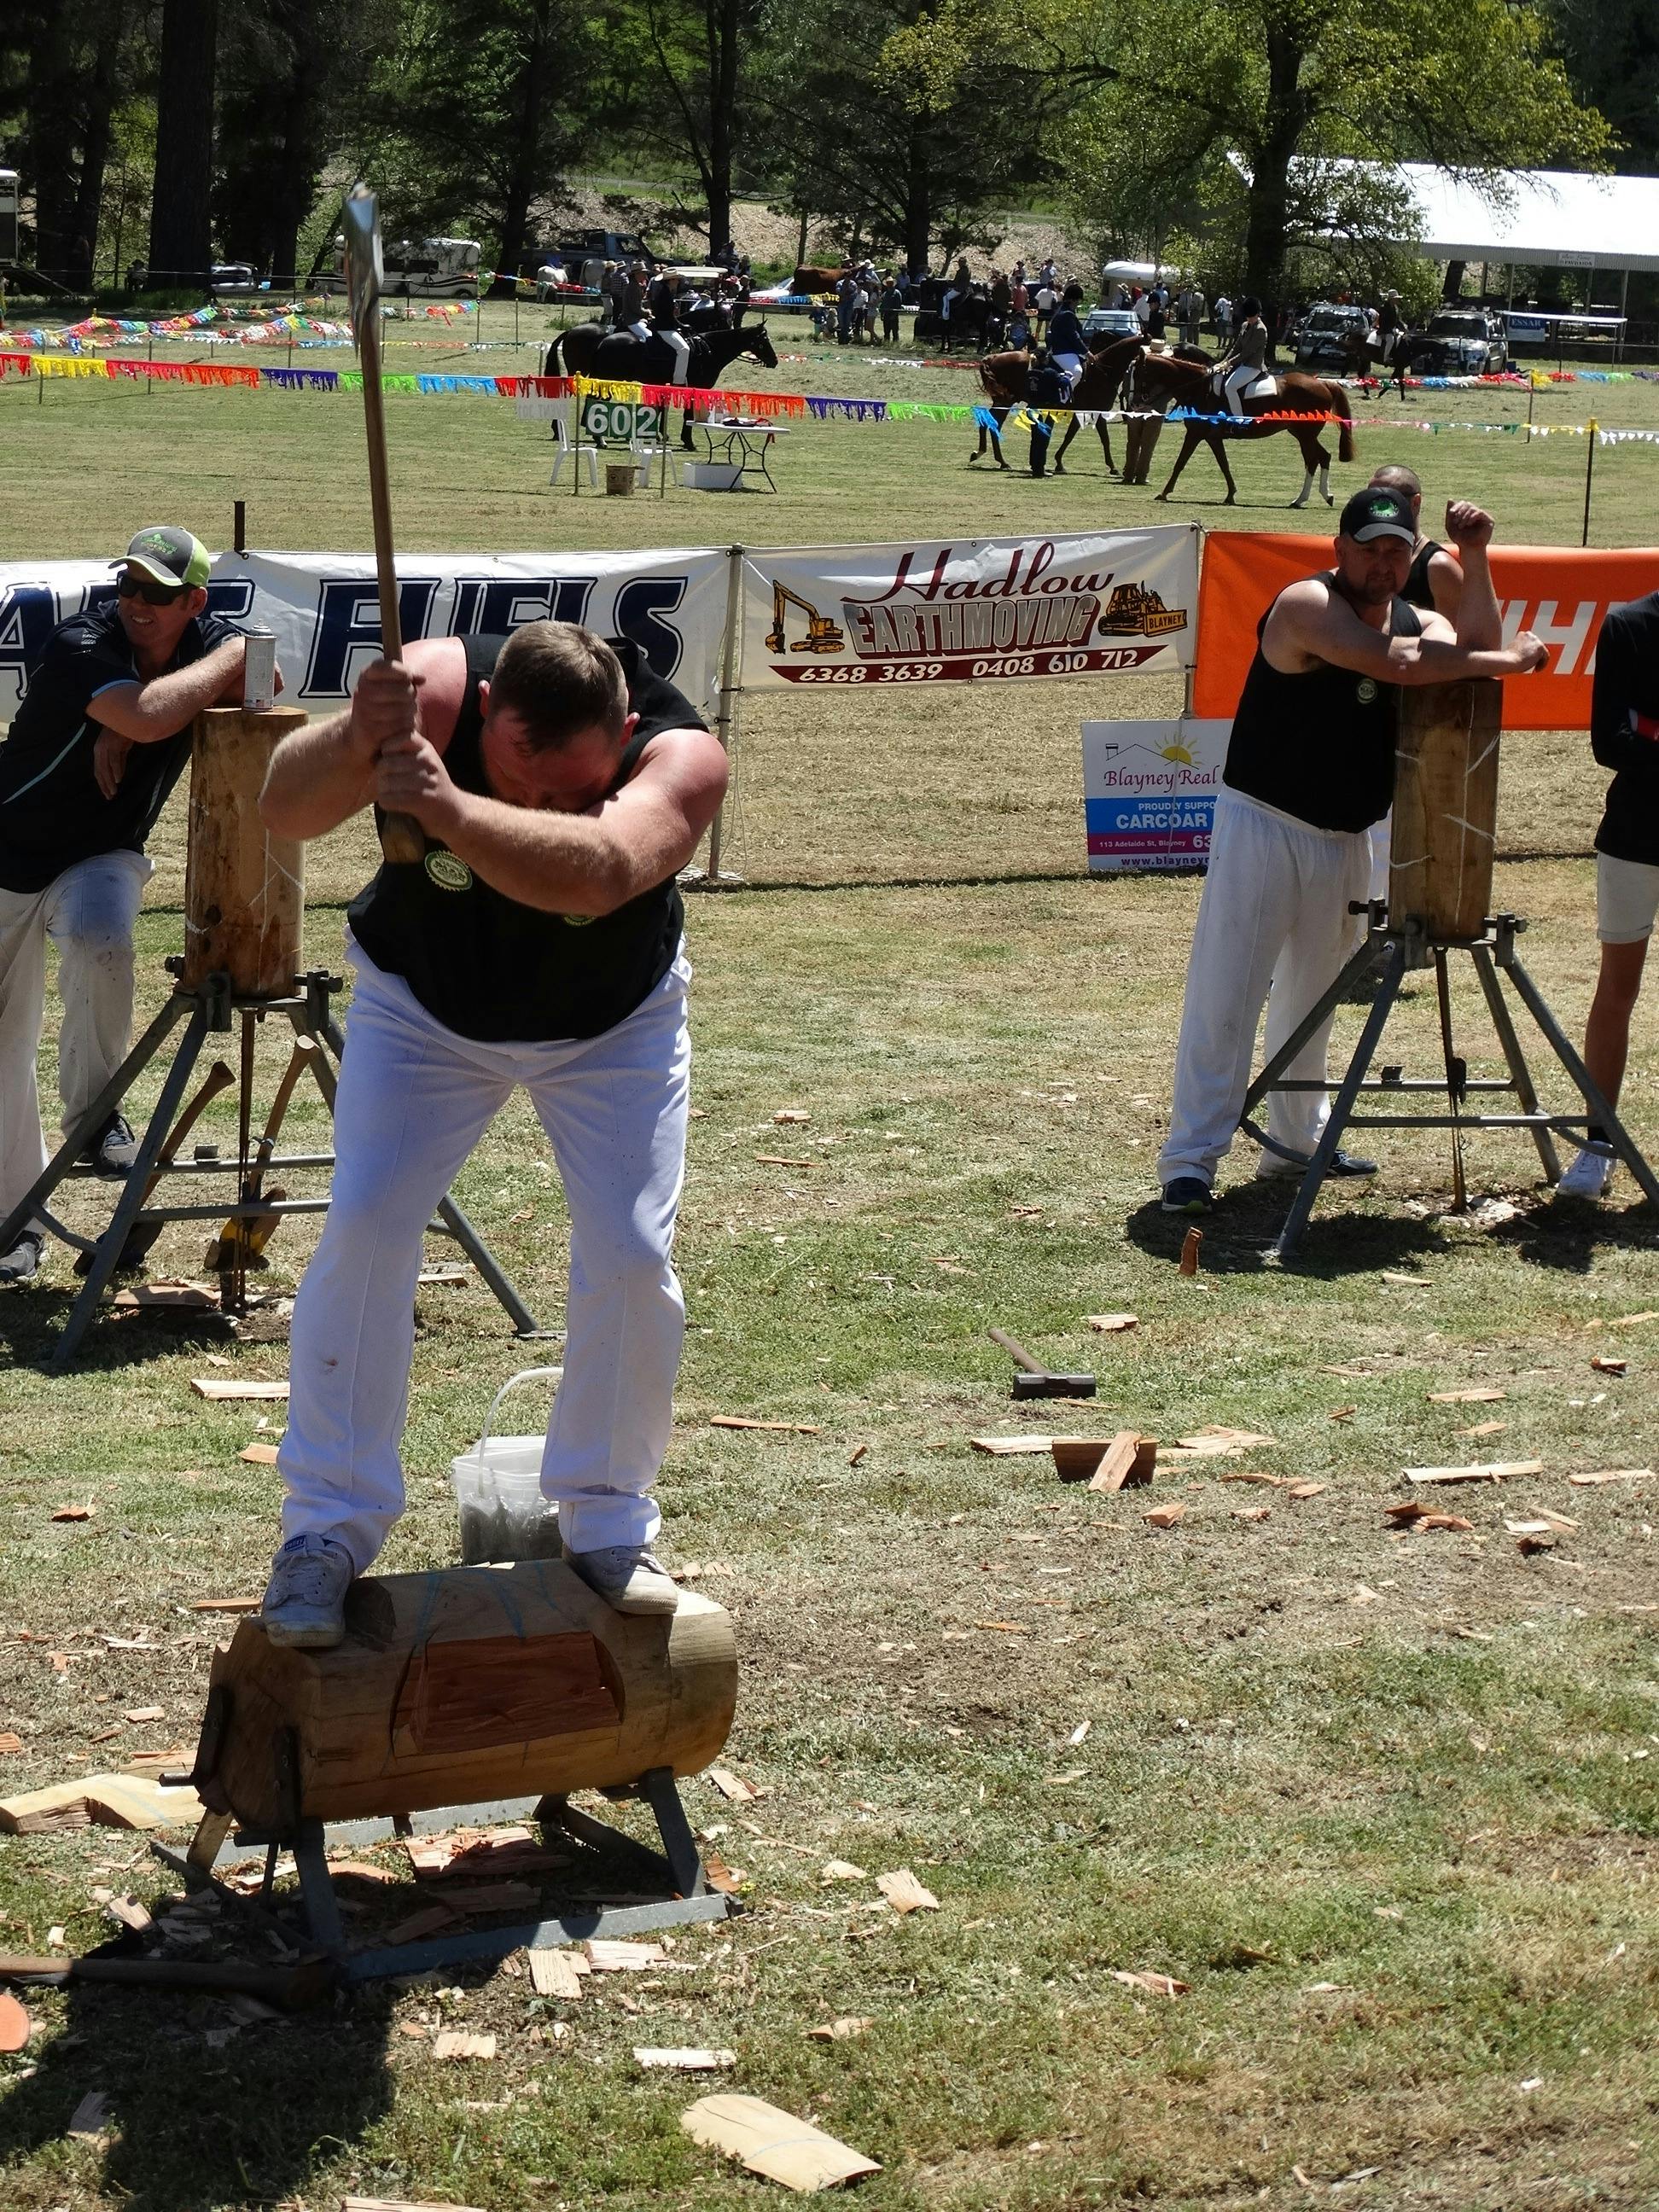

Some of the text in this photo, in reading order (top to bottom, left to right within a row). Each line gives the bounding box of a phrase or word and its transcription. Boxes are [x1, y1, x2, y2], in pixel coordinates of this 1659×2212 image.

[587, 404, 657, 437] 602
[840, 542, 1115, 602] Hadlow
[843, 594, 1101, 660] EARTHMOVING
[1149, 613, 1183, 630] BLAYNEY
[799, 649, 1138, 683] 6368 3639 0408 610 712
[1103, 765, 1220, 795] Blayney Real
[1115, 812, 1208, 830] CARCOAR
[1138, 801, 1182, 811] PROUDLY
[1115, 840, 1145, 848] Adelaide
[1159, 839, 1186, 847] Blayney
